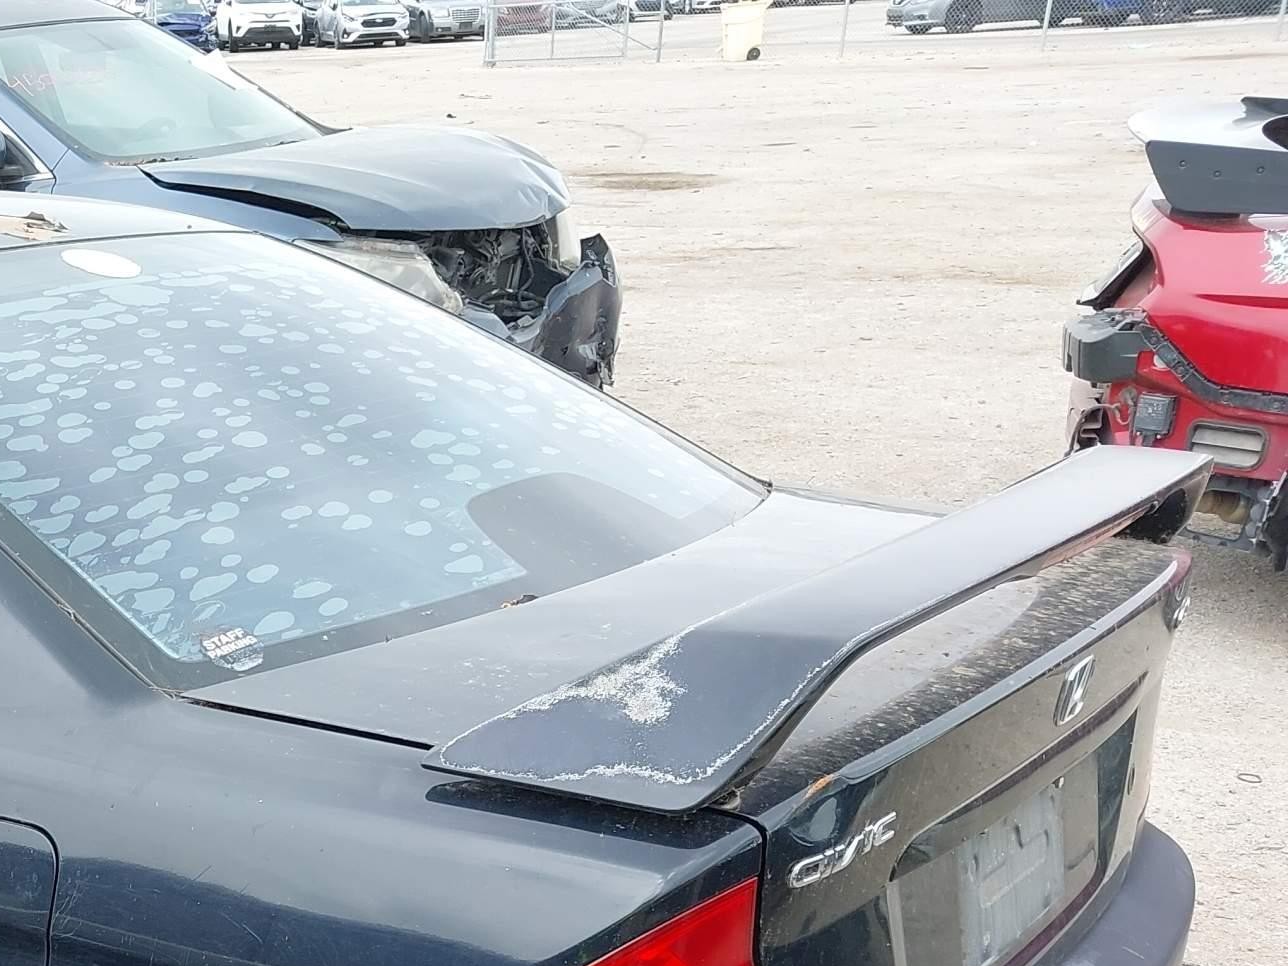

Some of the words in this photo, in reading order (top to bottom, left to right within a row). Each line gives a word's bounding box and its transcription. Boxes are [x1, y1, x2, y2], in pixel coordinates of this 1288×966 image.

[203, 628, 245, 651] STAFF
[208, 635, 257, 658] PARKING
[788, 811, 897, 888] CIVIC
